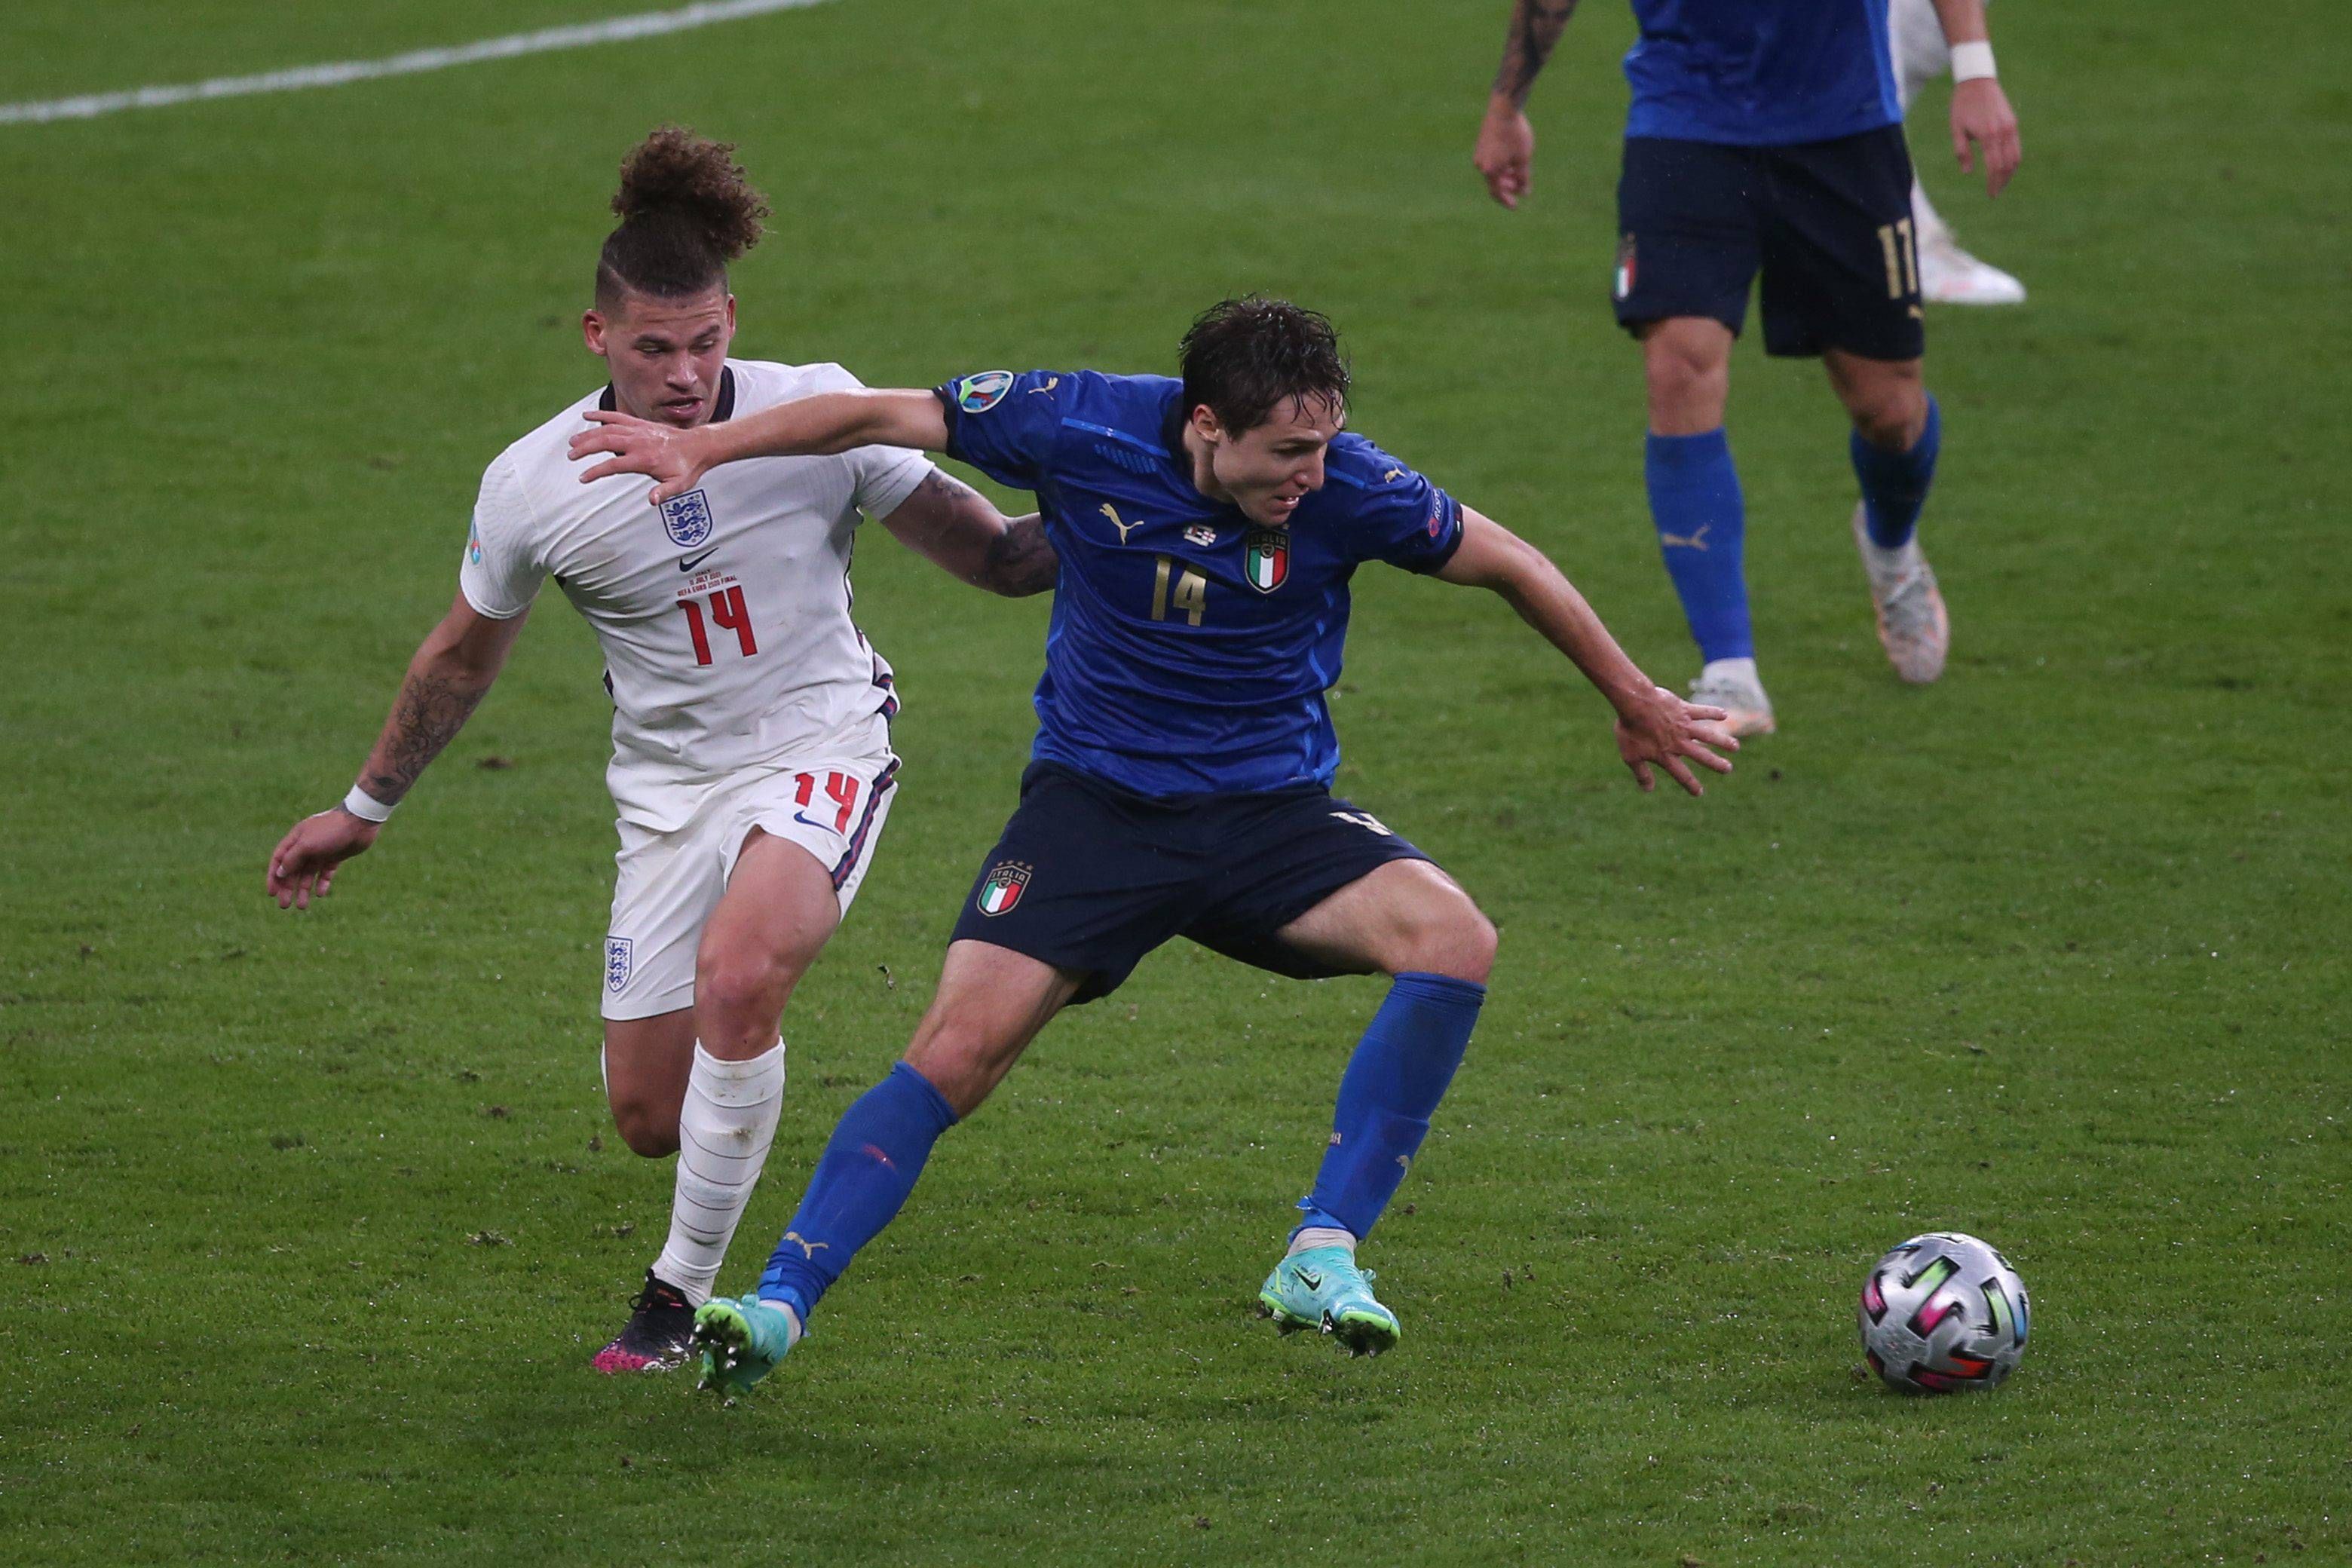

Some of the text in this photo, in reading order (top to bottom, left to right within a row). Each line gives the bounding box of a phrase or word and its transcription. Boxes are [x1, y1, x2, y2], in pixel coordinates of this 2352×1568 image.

[1876, 219, 1918, 299] 11
[678, 588, 691, 596] UEFA
[721, 575, 737, 585] FINAL
[696, 575, 708, 584] JULY
[1151, 554, 1206, 627] 14
[676, 585, 758, 666] 14
[794, 771, 859, 836] 14
[992, 870, 1025, 881] ITALIA
